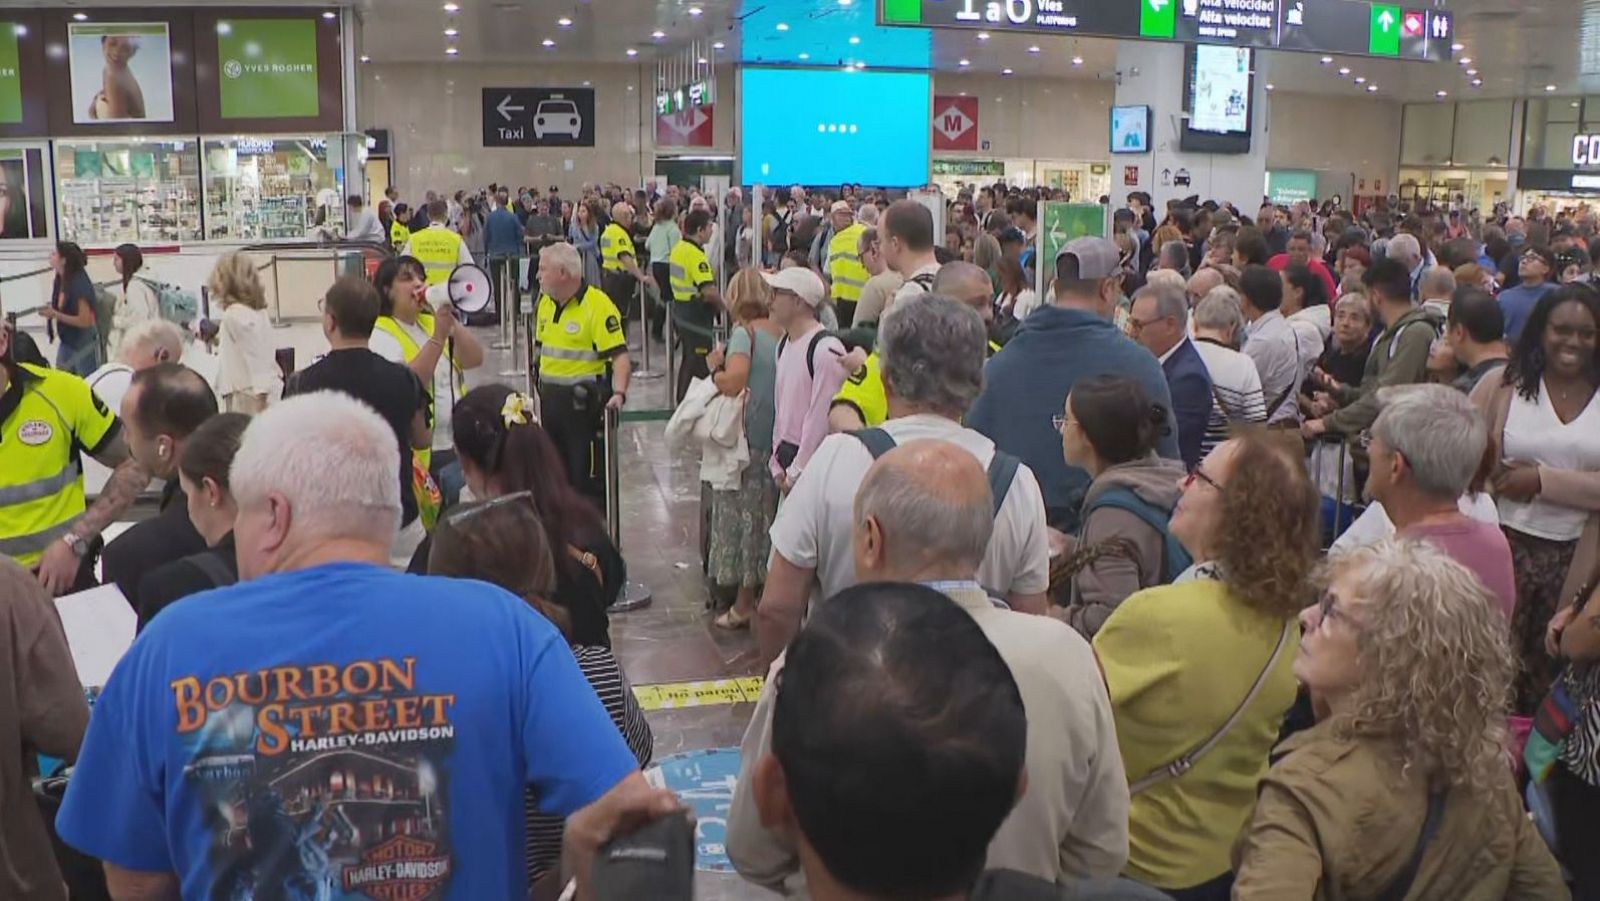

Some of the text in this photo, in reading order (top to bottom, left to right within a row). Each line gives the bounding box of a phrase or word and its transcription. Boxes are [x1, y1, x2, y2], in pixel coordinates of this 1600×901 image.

[1199, 10, 1271, 28] Alta velocitat
[245, 63, 313, 73] YVES ROCHER
[498, 126, 524, 139] Taxi
[944, 115, 961, 131] M
[170, 658, 415, 733] BOURBON
[256, 694, 455, 755] STREET
[290, 725, 454, 753] HARLEY-DAVIDSON
[349, 859, 448, 886] HARLEY-DAVIDSON
